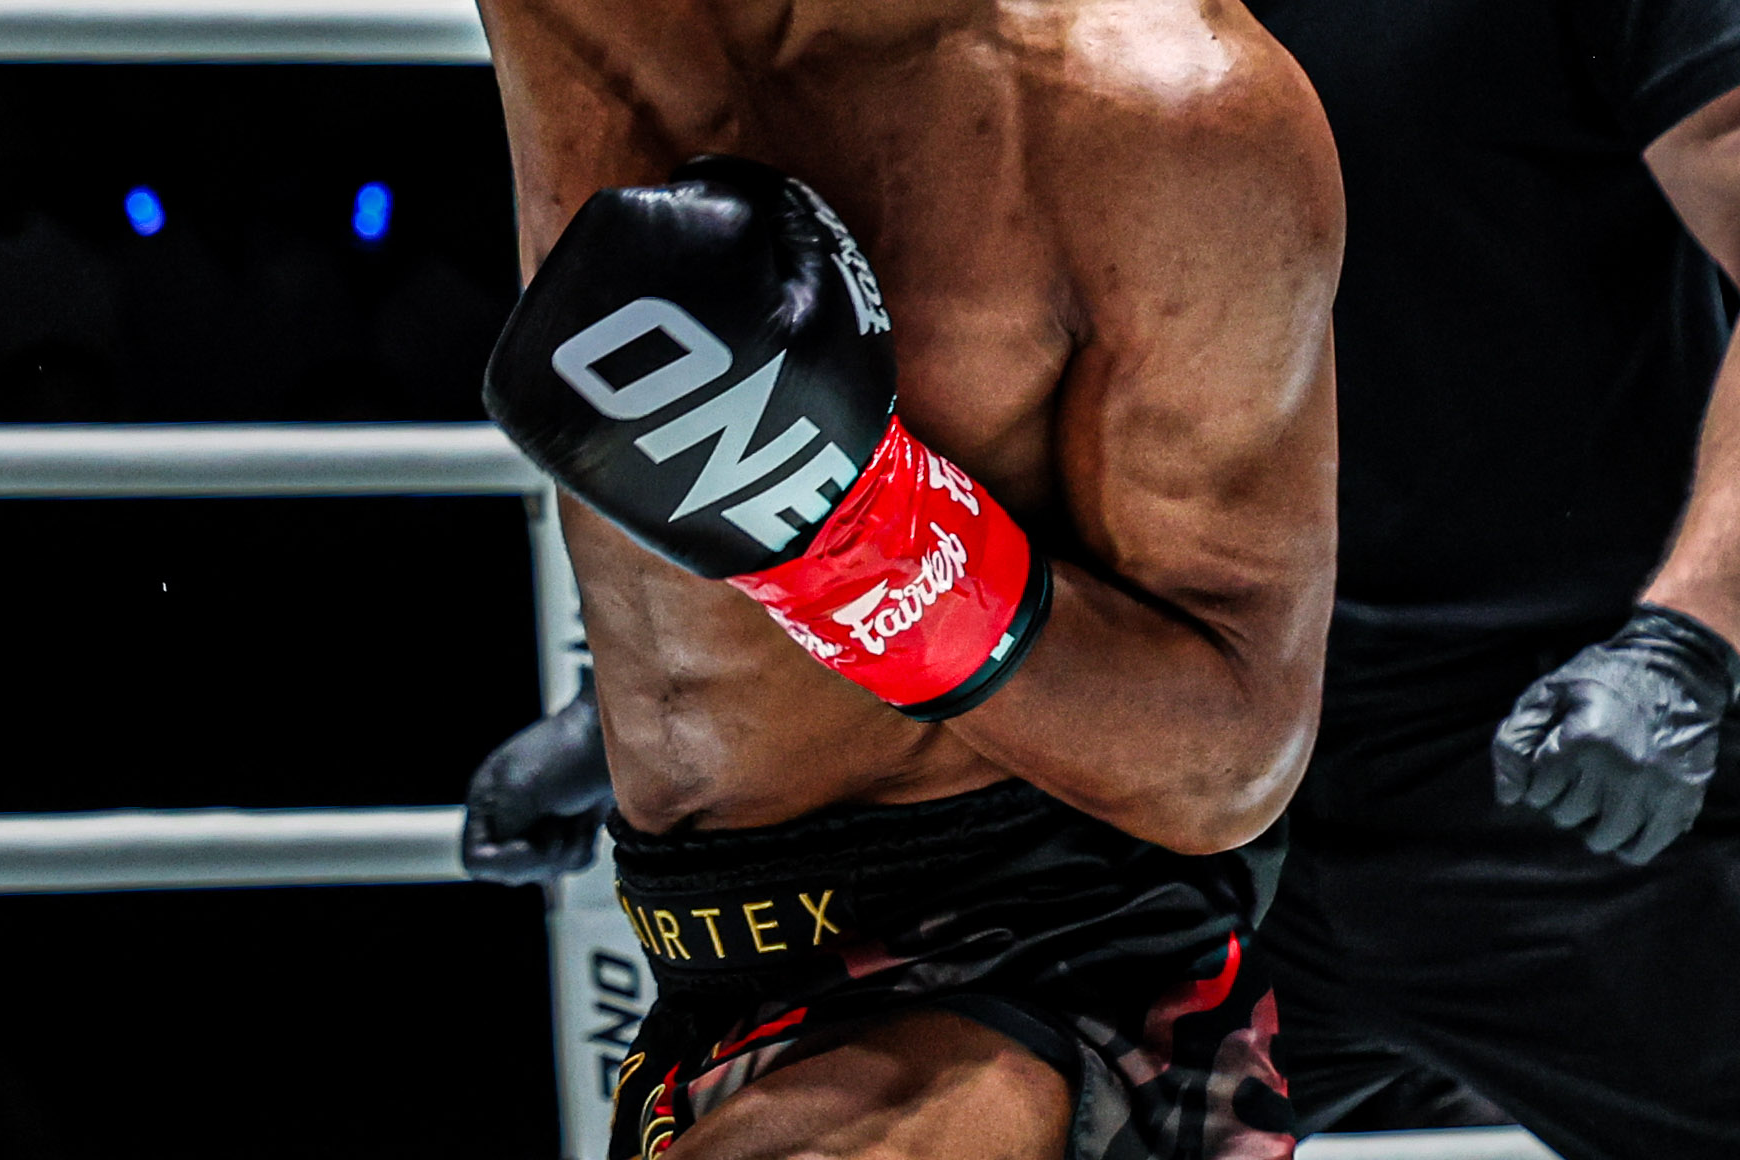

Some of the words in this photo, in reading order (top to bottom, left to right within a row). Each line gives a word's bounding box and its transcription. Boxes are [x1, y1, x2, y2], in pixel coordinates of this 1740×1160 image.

[551, 297, 859, 552] ONE
[831, 521, 968, 655] Fairtex
[615, 878, 842, 961] IRTEX
